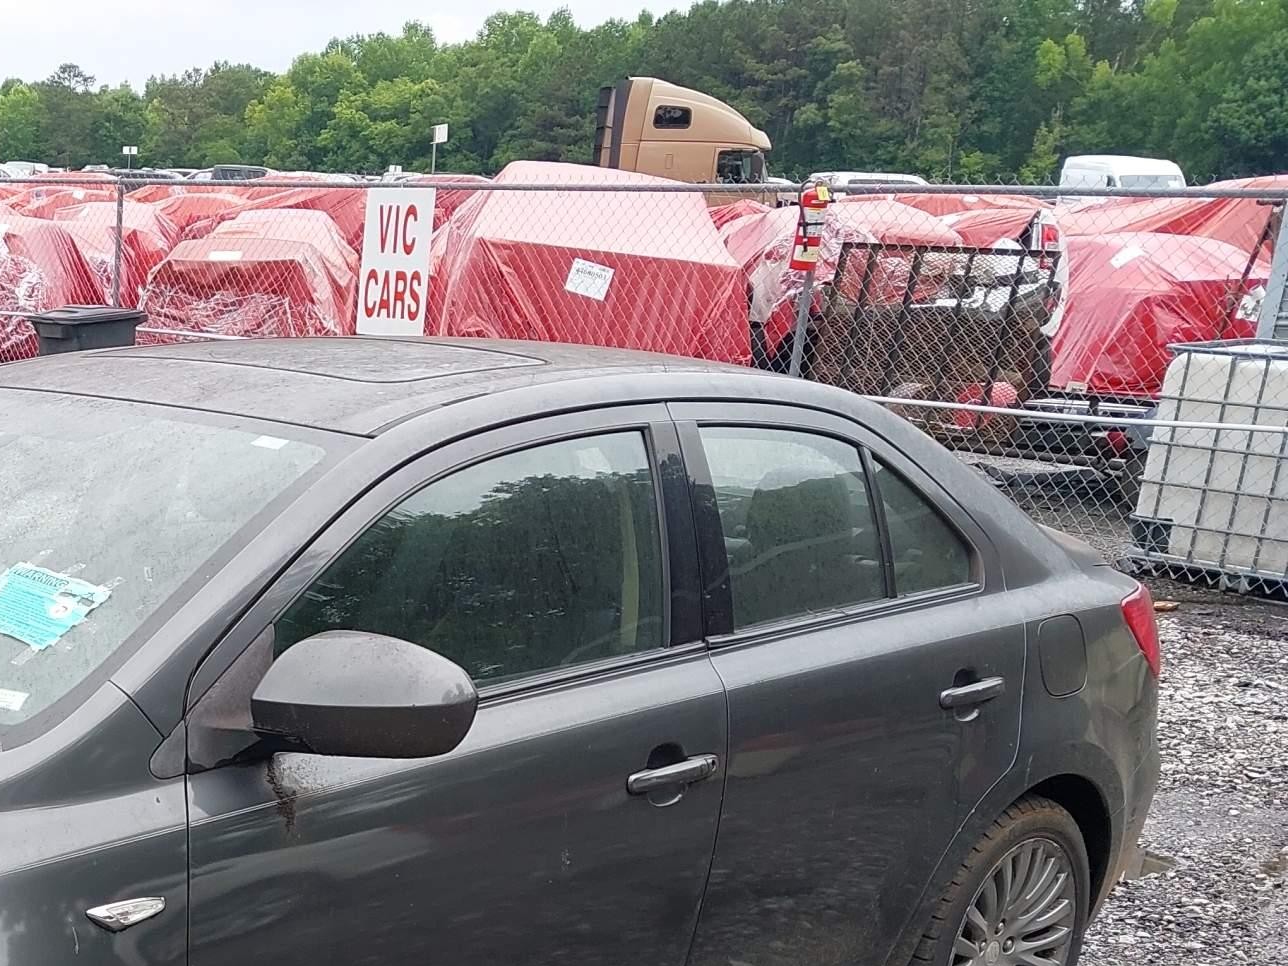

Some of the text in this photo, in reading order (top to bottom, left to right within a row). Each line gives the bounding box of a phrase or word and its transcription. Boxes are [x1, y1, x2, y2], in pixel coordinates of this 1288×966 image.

[379, 204, 418, 255] VIC
[364, 268, 421, 321] CARS
[12, 566, 70, 588] WARNING
